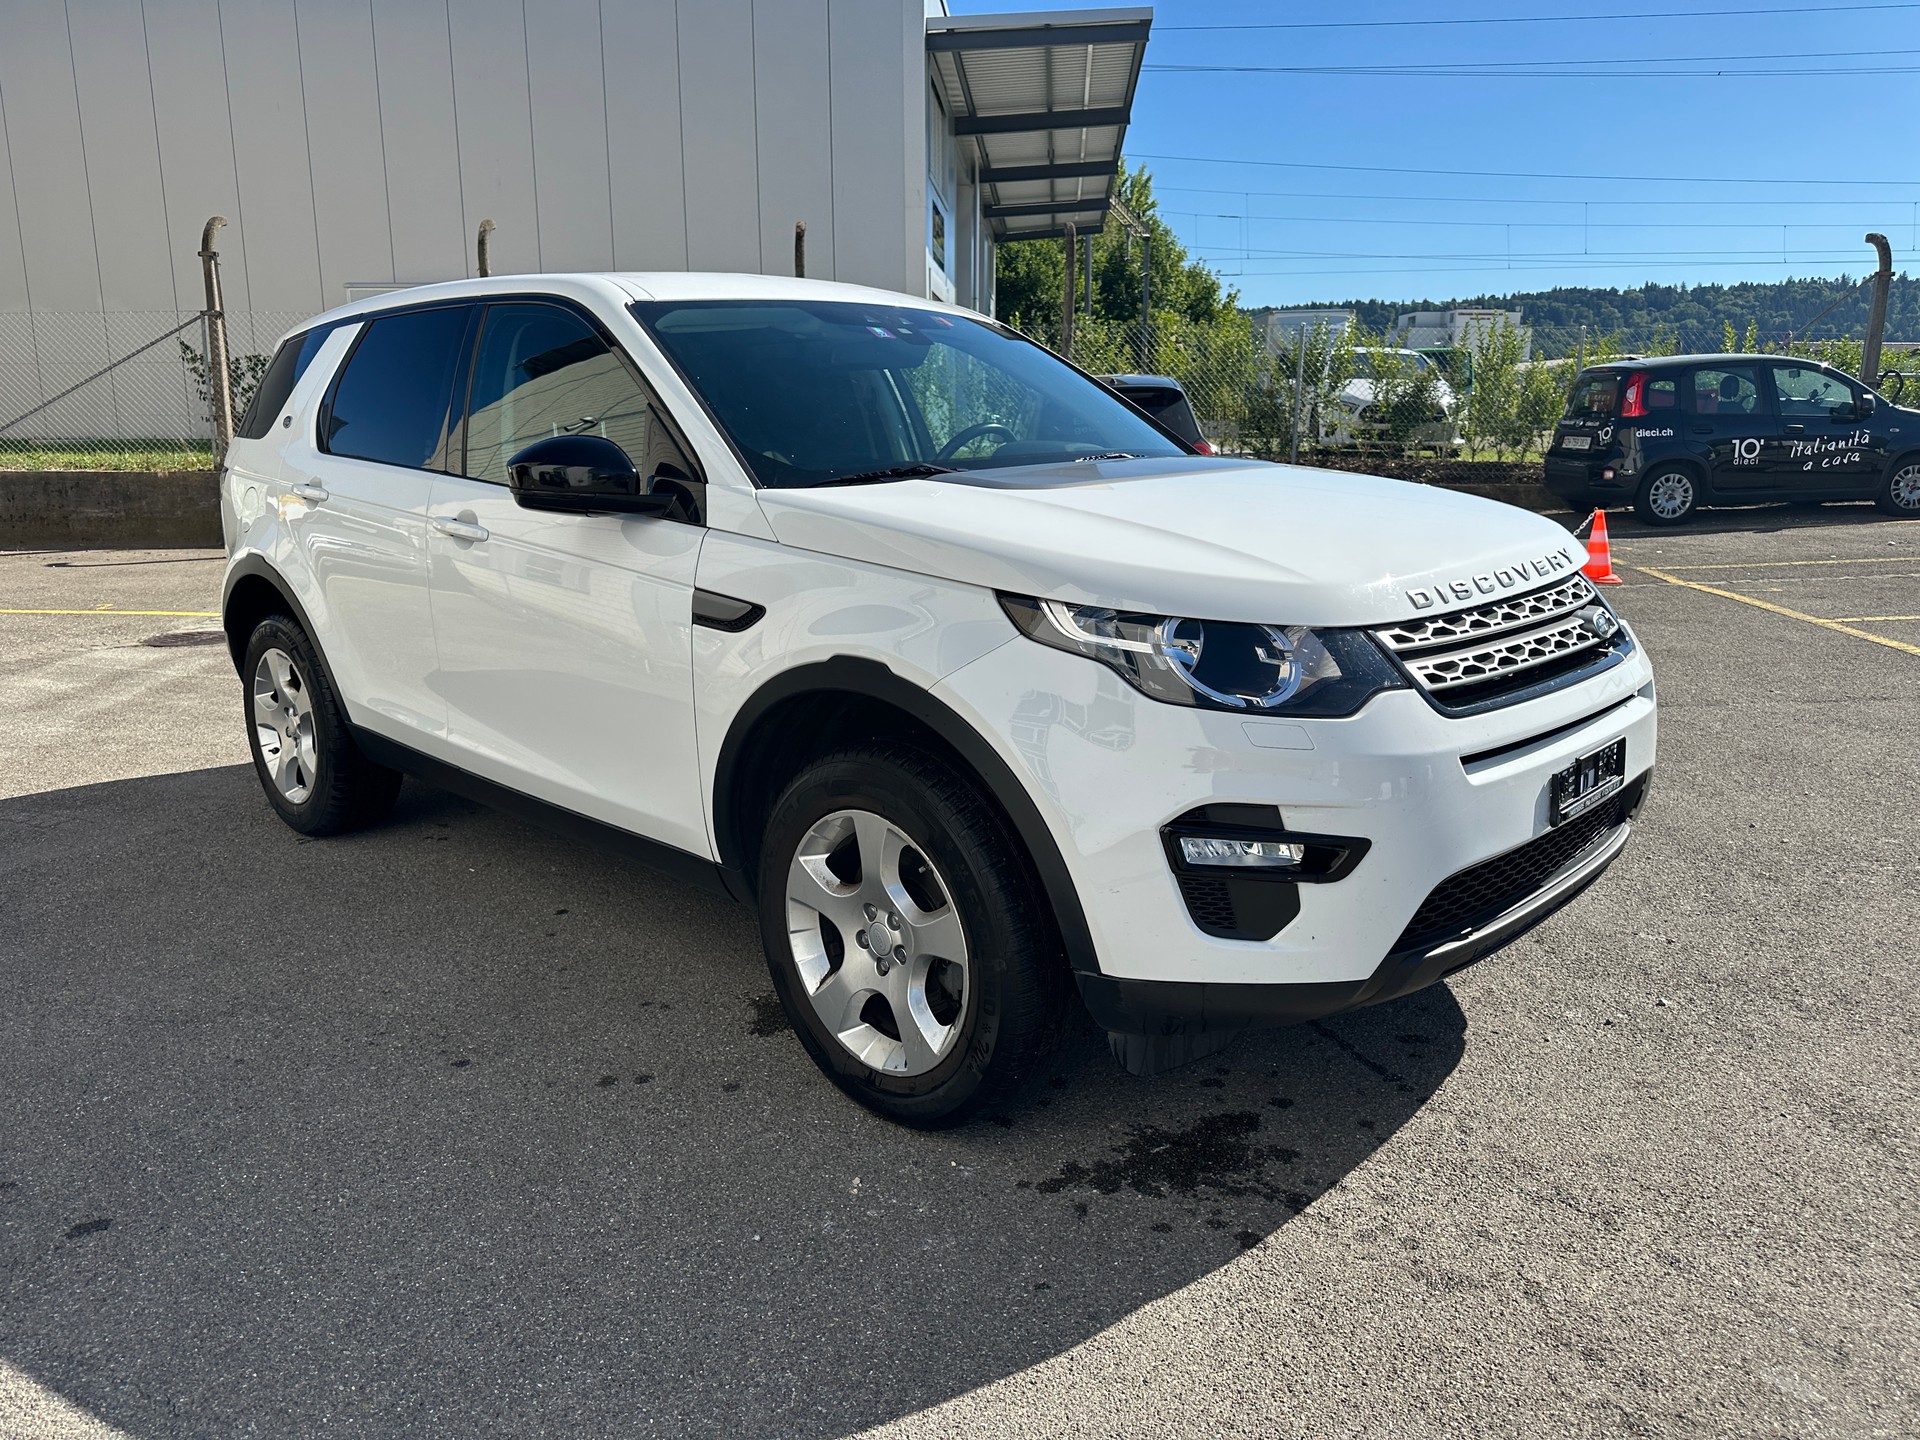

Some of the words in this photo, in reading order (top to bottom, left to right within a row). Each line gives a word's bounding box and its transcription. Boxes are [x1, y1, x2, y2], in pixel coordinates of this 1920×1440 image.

[1636, 427, 1674, 438] dieci.ch
[1790, 428, 1871, 458] italianità
[1733, 457, 1759, 465] dieci
[1802, 461, 1813, 471] a
[1821, 452, 1861, 468] casa
[1405, 547, 1575, 610] DISCOVERY
